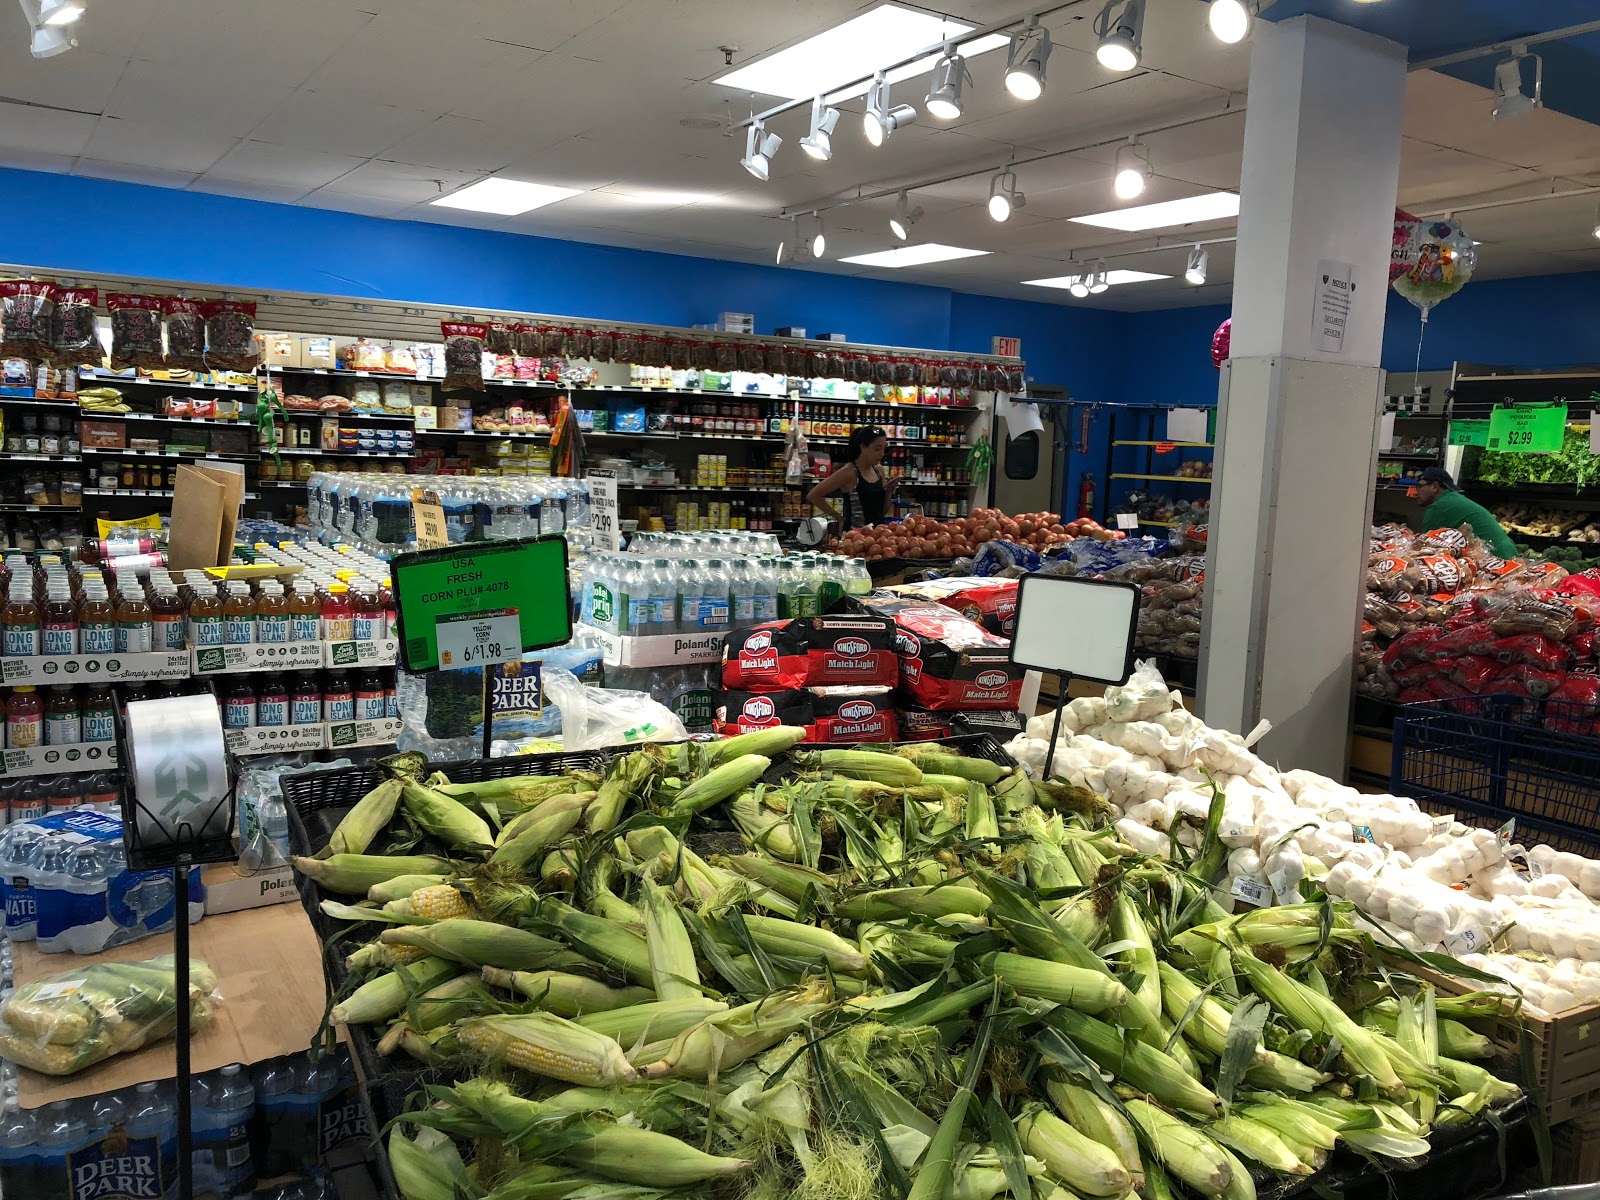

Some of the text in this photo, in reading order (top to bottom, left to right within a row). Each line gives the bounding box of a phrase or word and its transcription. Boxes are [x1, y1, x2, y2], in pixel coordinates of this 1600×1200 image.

[1332, 279, 1347, 289] NOTICE
[1324, 315, 1344, 326] SECURITY
[1324, 328, 1341, 338] OFFICER
[998, 338, 1017, 356] EXIT
[1508, 431, 1533, 446] $2.99
[592, 513, 612, 532] $2.99
[452, 559, 475, 569] USA
[447, 571, 483, 584] FRESH
[422, 582, 510, 604] CORN PLU# 4078
[198, 622, 222, 633] LONG
[227, 622, 250, 634] LONG
[262, 622, 286, 632] LONG
[292, 621, 316, 631] LONG
[329, 622, 352, 632] LONG
[5, 632, 32, 644] LONG
[44, 632, 72, 642] LONG
[85, 630, 112, 641] LONG
[675, 638, 709, 654] Poland
[836, 641, 868, 655] KINGSFORD
[464, 643, 502, 661] 6/$1.98
[285, 658, 320, 667] refreshing
[586, 662, 598, 671] 24
[742, 658, 776, 670] Match Light
[828, 659, 874, 669] Match Light
[120, 668, 188, 678] Simply refreshing
[979, 674, 1006, 687] KINGSFORD
[966, 690, 1008, 700] Match Light
[260, 704, 282, 714] LONG
[294, 703, 318, 713] LONG
[841, 704, 873, 718] KINGSFORD
[675, 704, 712, 724] Sprin
[12, 724, 35, 732] LONG
[86, 718, 112, 729] LONG
[834, 722, 882, 735] Match Light
[286, 740, 321, 749] refreshing
[260, 879, 295, 896] Polan
[230, 1125, 246, 1136] 24
[75, 1156, 155, 1188] DEER
[76, 1176, 157, 1200] PARK
